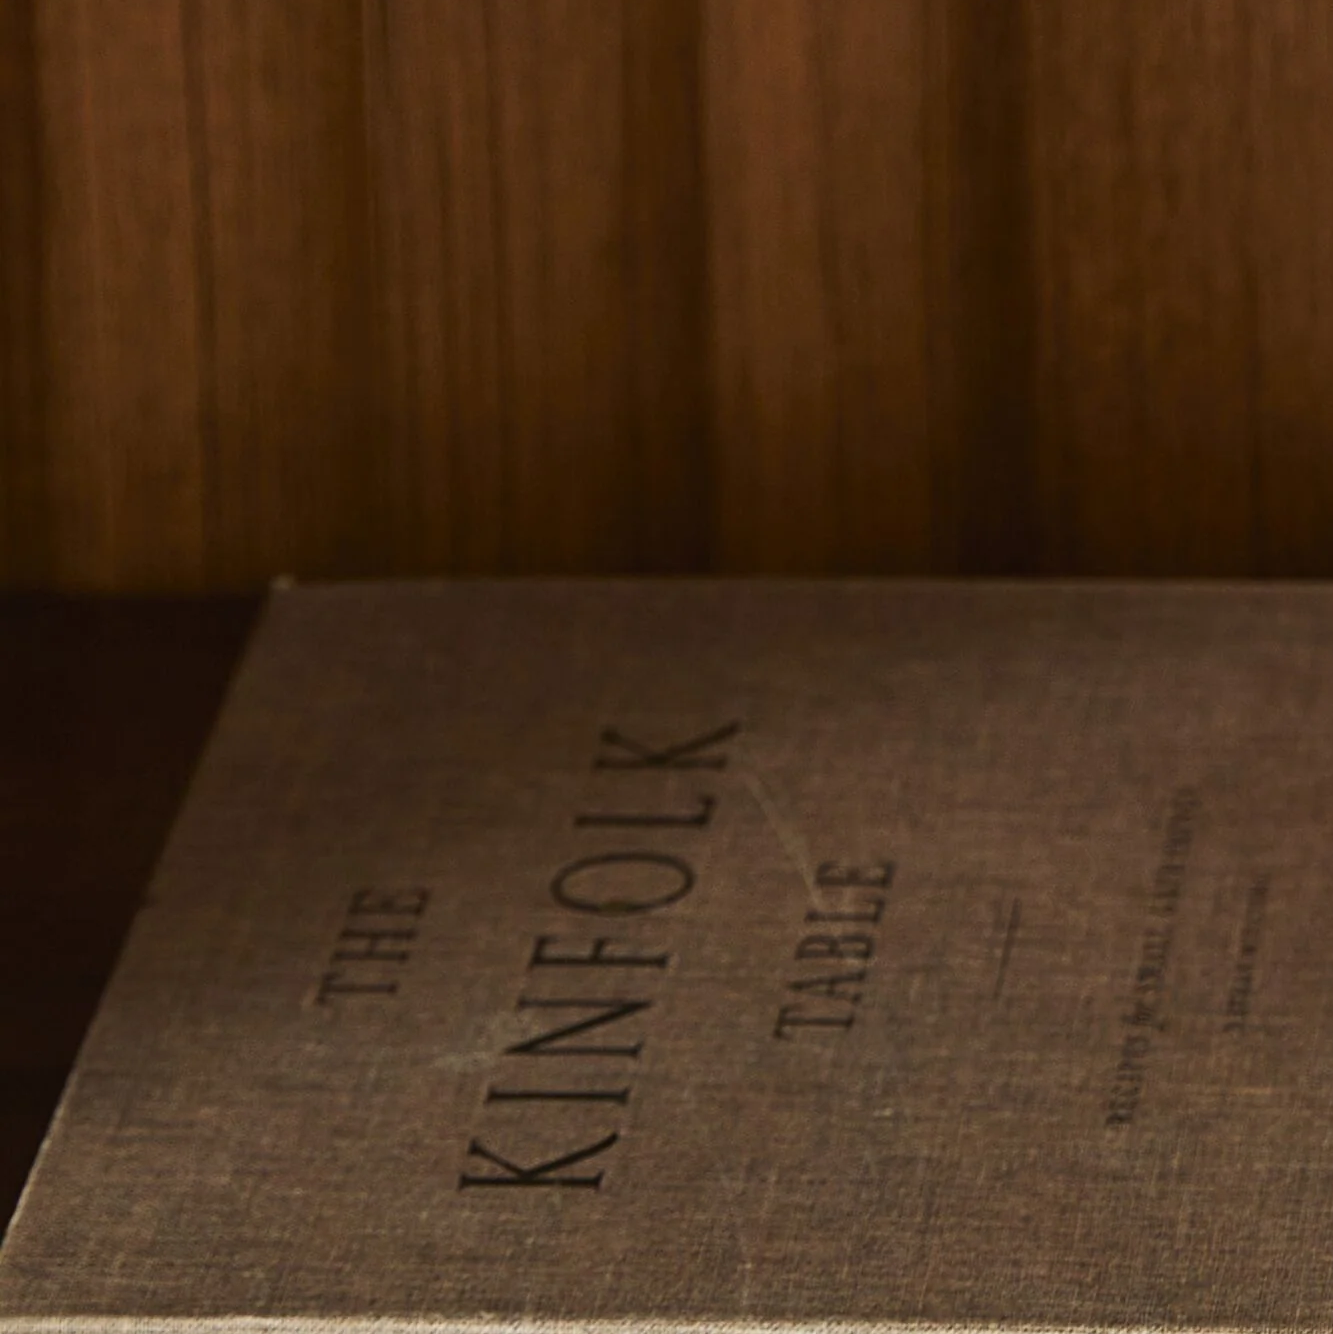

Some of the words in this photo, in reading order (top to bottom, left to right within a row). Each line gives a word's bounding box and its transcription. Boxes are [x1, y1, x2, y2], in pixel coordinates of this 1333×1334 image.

[314, 883, 431, 1009] THE
[458, 719, 742, 1190] KINFOLK
[774, 858, 896, 1039] TABLE
